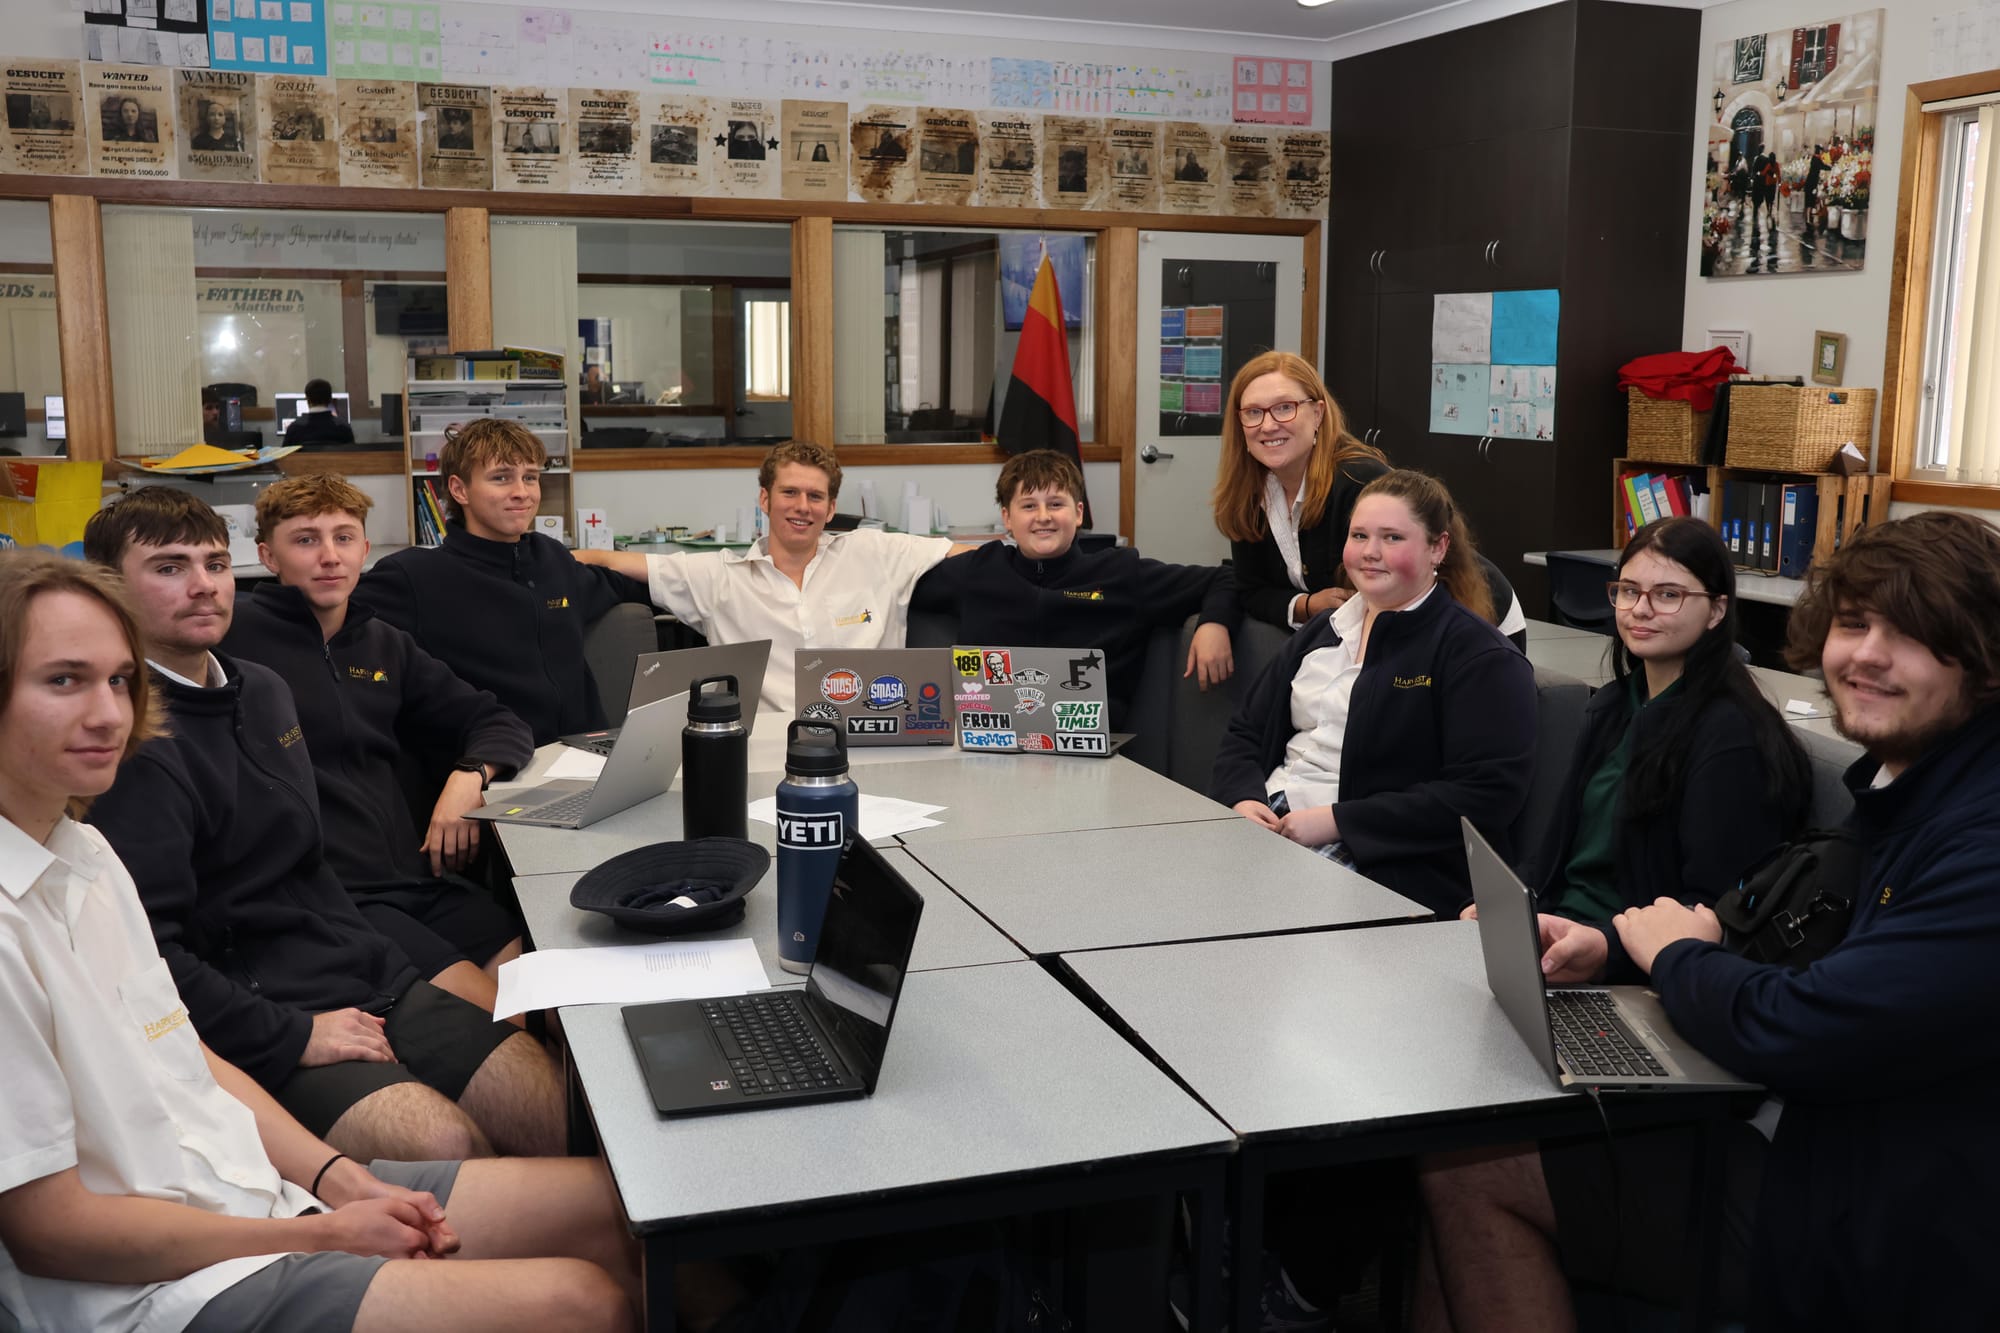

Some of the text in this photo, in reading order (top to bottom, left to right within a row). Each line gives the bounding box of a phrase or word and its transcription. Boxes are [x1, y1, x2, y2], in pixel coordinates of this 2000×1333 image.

[6, 69, 65, 80] GESUCHT
[102, 72, 149, 82] WANTED
[182, 70, 248, 86] WANTED
[357, 86, 395, 95] Gesucht
[430, 87, 479, 100] GESUCHT
[581, 100, 628, 109] GESUCHT
[505, 110, 555, 119] GESUCHT
[926, 118, 969, 128] GESUCHT
[991, 121, 1031, 130] GESUCHT
[1113, 129, 1153, 138] GESUCHT
[1176, 130, 1208, 138] GESUCHT
[1229, 135, 1267, 144] GESUCHT
[138, 169, 169, 177] $100,000
[206, 287, 283, 302] FATHER
[955, 656, 981, 672] 189
[824, 677, 859, 695] SMASA
[870, 683, 904, 699] SMASA
[1068, 703, 1101, 716] FAST
[850, 719, 895, 732] YETI
[905, 714, 950, 730] Search
[962, 712, 1011, 729] FROTH
[1058, 717, 1098, 731] TIMES
[1058, 736, 1102, 750] YETI
[777, 817, 837, 843] YETI
